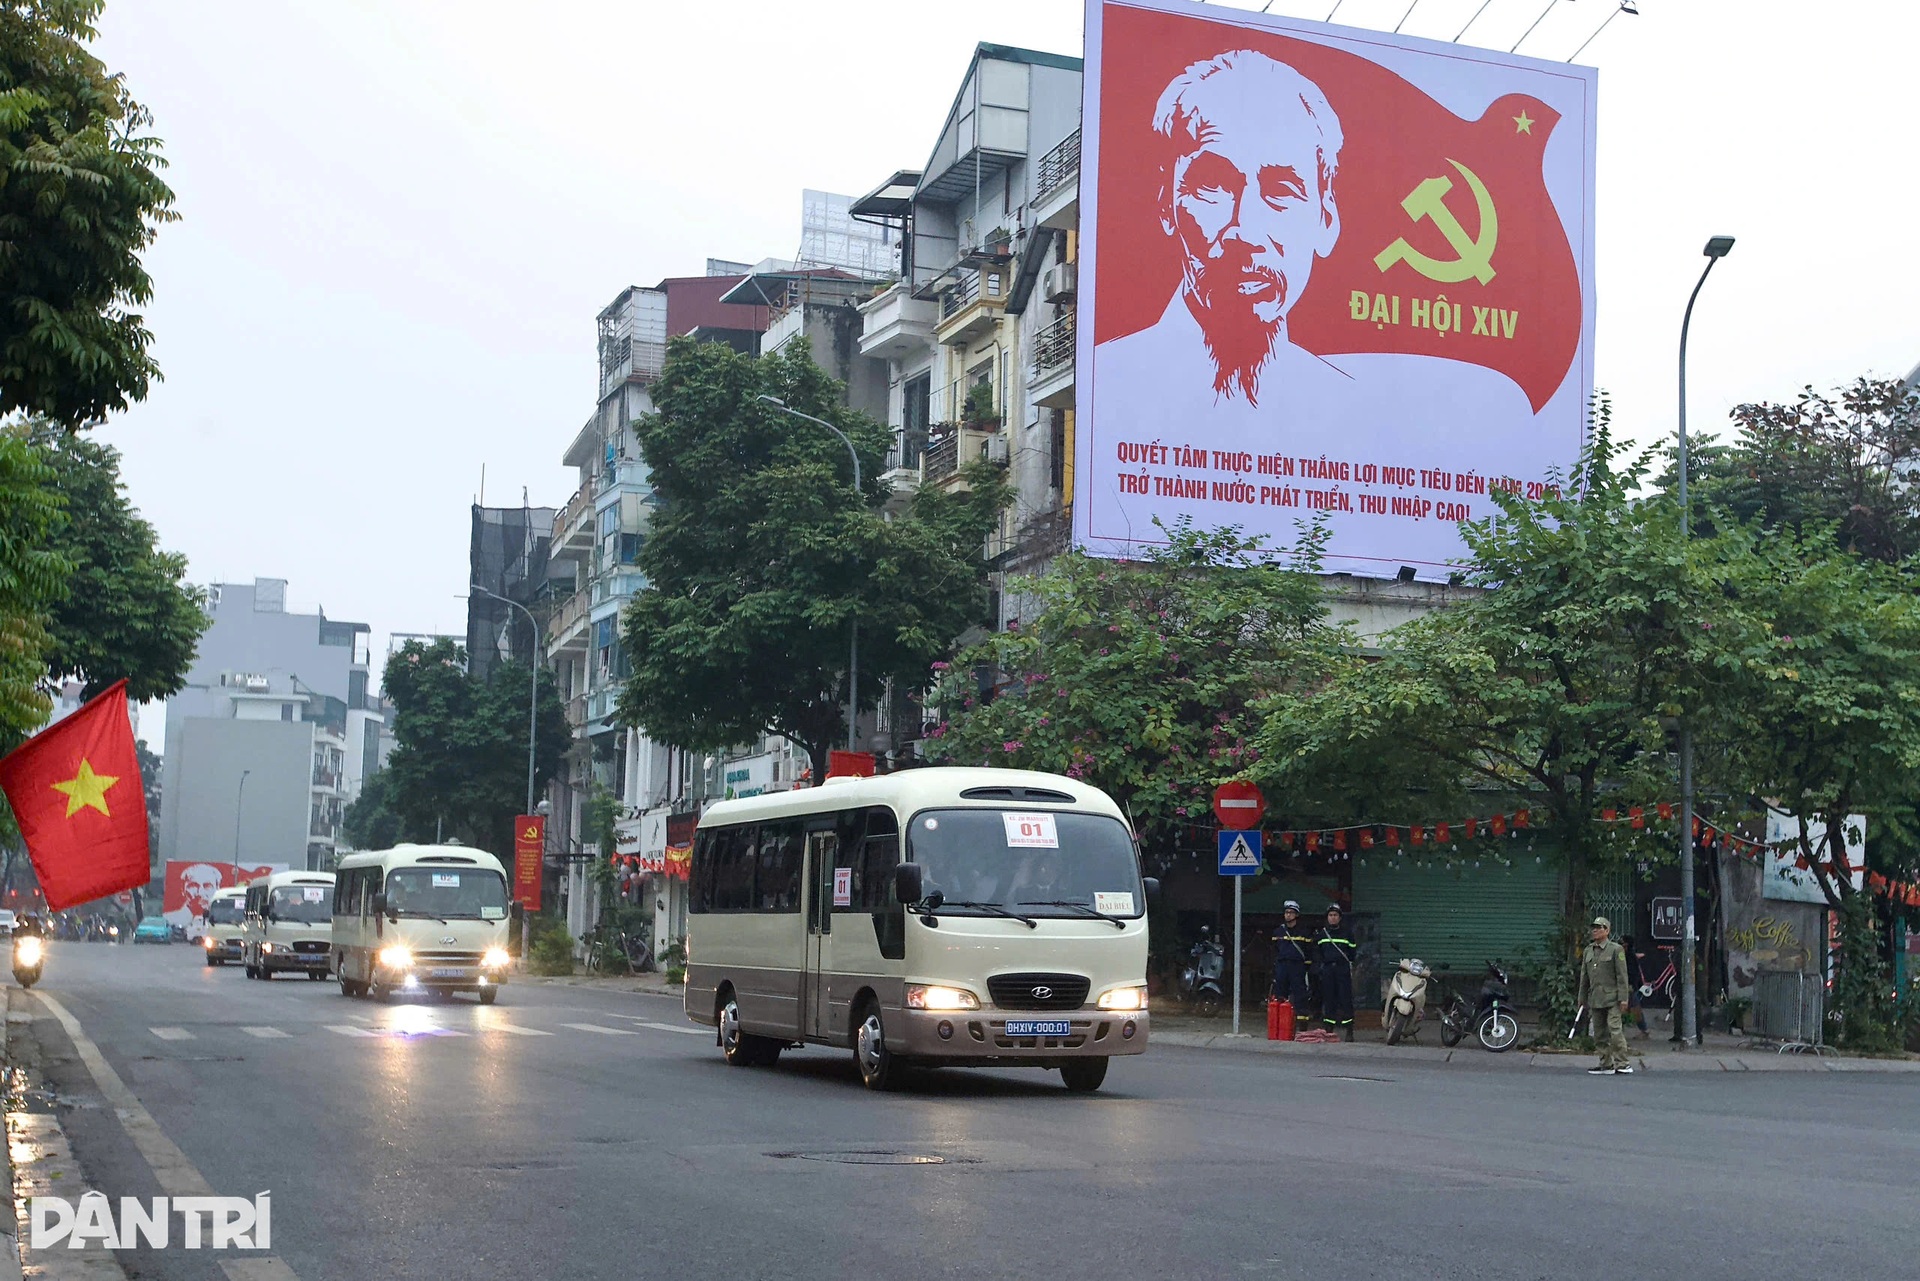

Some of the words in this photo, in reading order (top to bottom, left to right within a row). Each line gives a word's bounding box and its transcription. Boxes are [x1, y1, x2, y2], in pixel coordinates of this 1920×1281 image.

[1349, 290, 1400, 330] ĐẠI
[1411, 294, 1461, 338] HỘI
[1471, 305, 1519, 339] XIV
[1117, 438, 1169, 465] QUYẾT
[1172, 443, 1208, 469] TÂM
[1212, 450, 1253, 476] THỰC
[1257, 452, 1294, 480] HIỆN
[1299, 454, 1350, 481] THẮNG
[1354, 463, 1377, 487] LỢI
[1382, 466, 1416, 490] MỤC
[1420, 468, 1451, 491] TIÊU
[1455, 469, 1485, 495] ĐẾN
[1117, 467, 1150, 495] TRỞ
[1154, 474, 1207, 500] THÀNH
[1212, 478, 1256, 505] NƯỚC
[1260, 484, 1300, 508] PHÁT
[1305, 484, 1354, 514] TRIỂN,
[1359, 494, 1387, 515] THU
[1391, 495, 1432, 521] NHẬP
[1436, 504, 1471, 523] CAO!
[1020, 822, 1042, 837] 01
[838, 879, 846, 894] 01
[1754, 917, 1800, 948] Coffee
